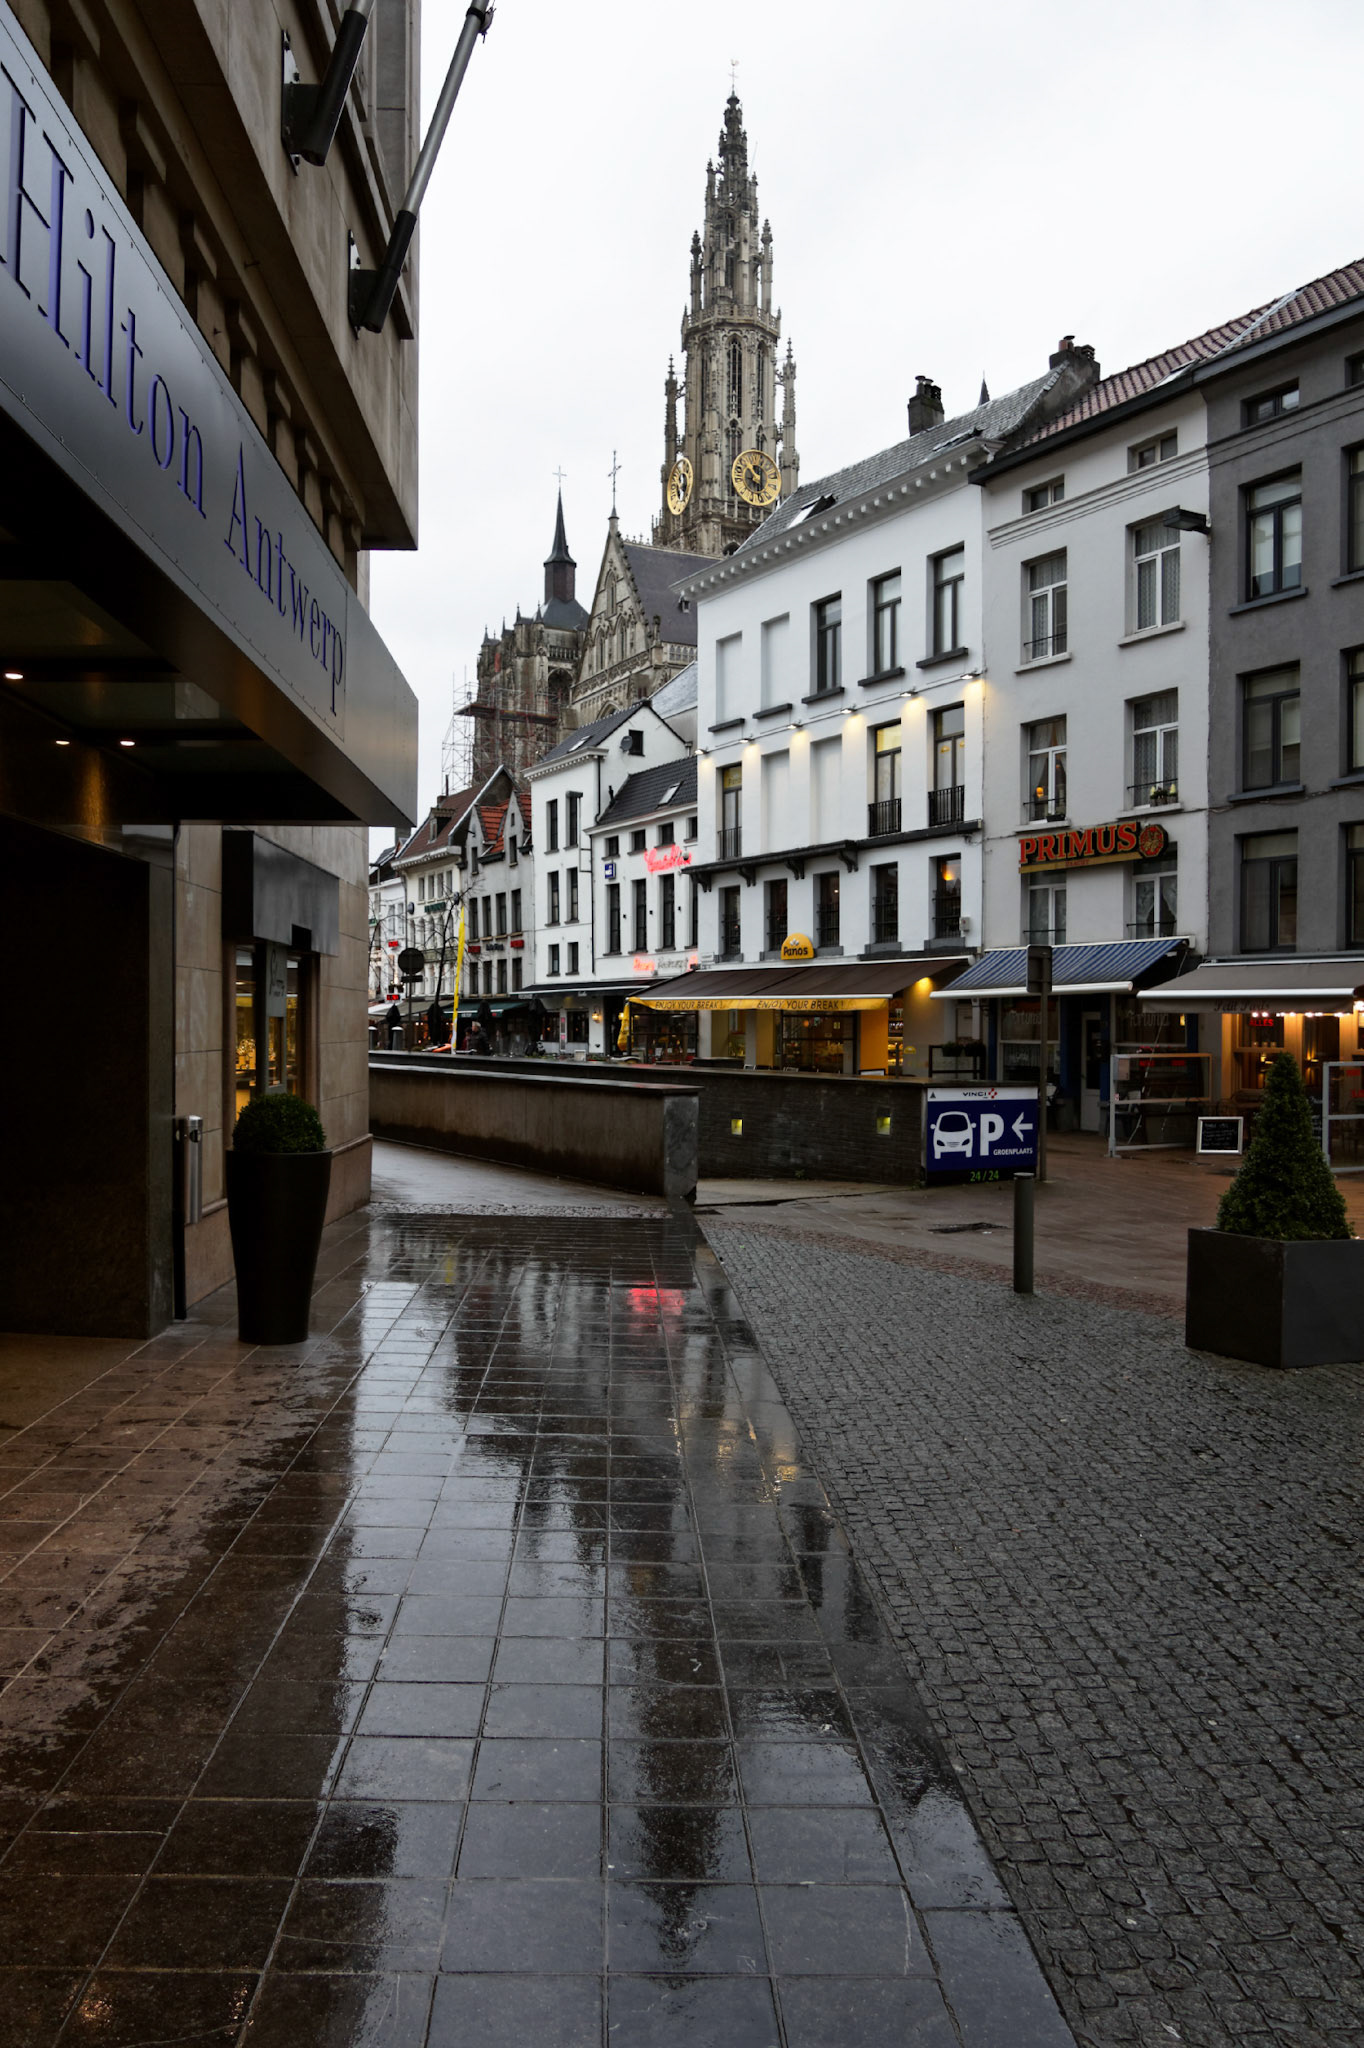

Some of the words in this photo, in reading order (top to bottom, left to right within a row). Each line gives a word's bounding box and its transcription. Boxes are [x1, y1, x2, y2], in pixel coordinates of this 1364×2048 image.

[0, 62, 206, 520] Hilton
[223, 442, 345, 716] Antwerp
[1018, 821, 1137, 864] PRIMUS
[783, 946, 809, 956] Panos
[655, 1001, 676, 1009] ENJOY
[677, 1001, 695, 1010] YOUR
[756, 1000, 784, 1009] ENJOY
[786, 1000, 809, 1010] YOUR
[979, 1113, 1005, 1156] P
[993, 1148, 1033, 1156] GROENPLAATS
